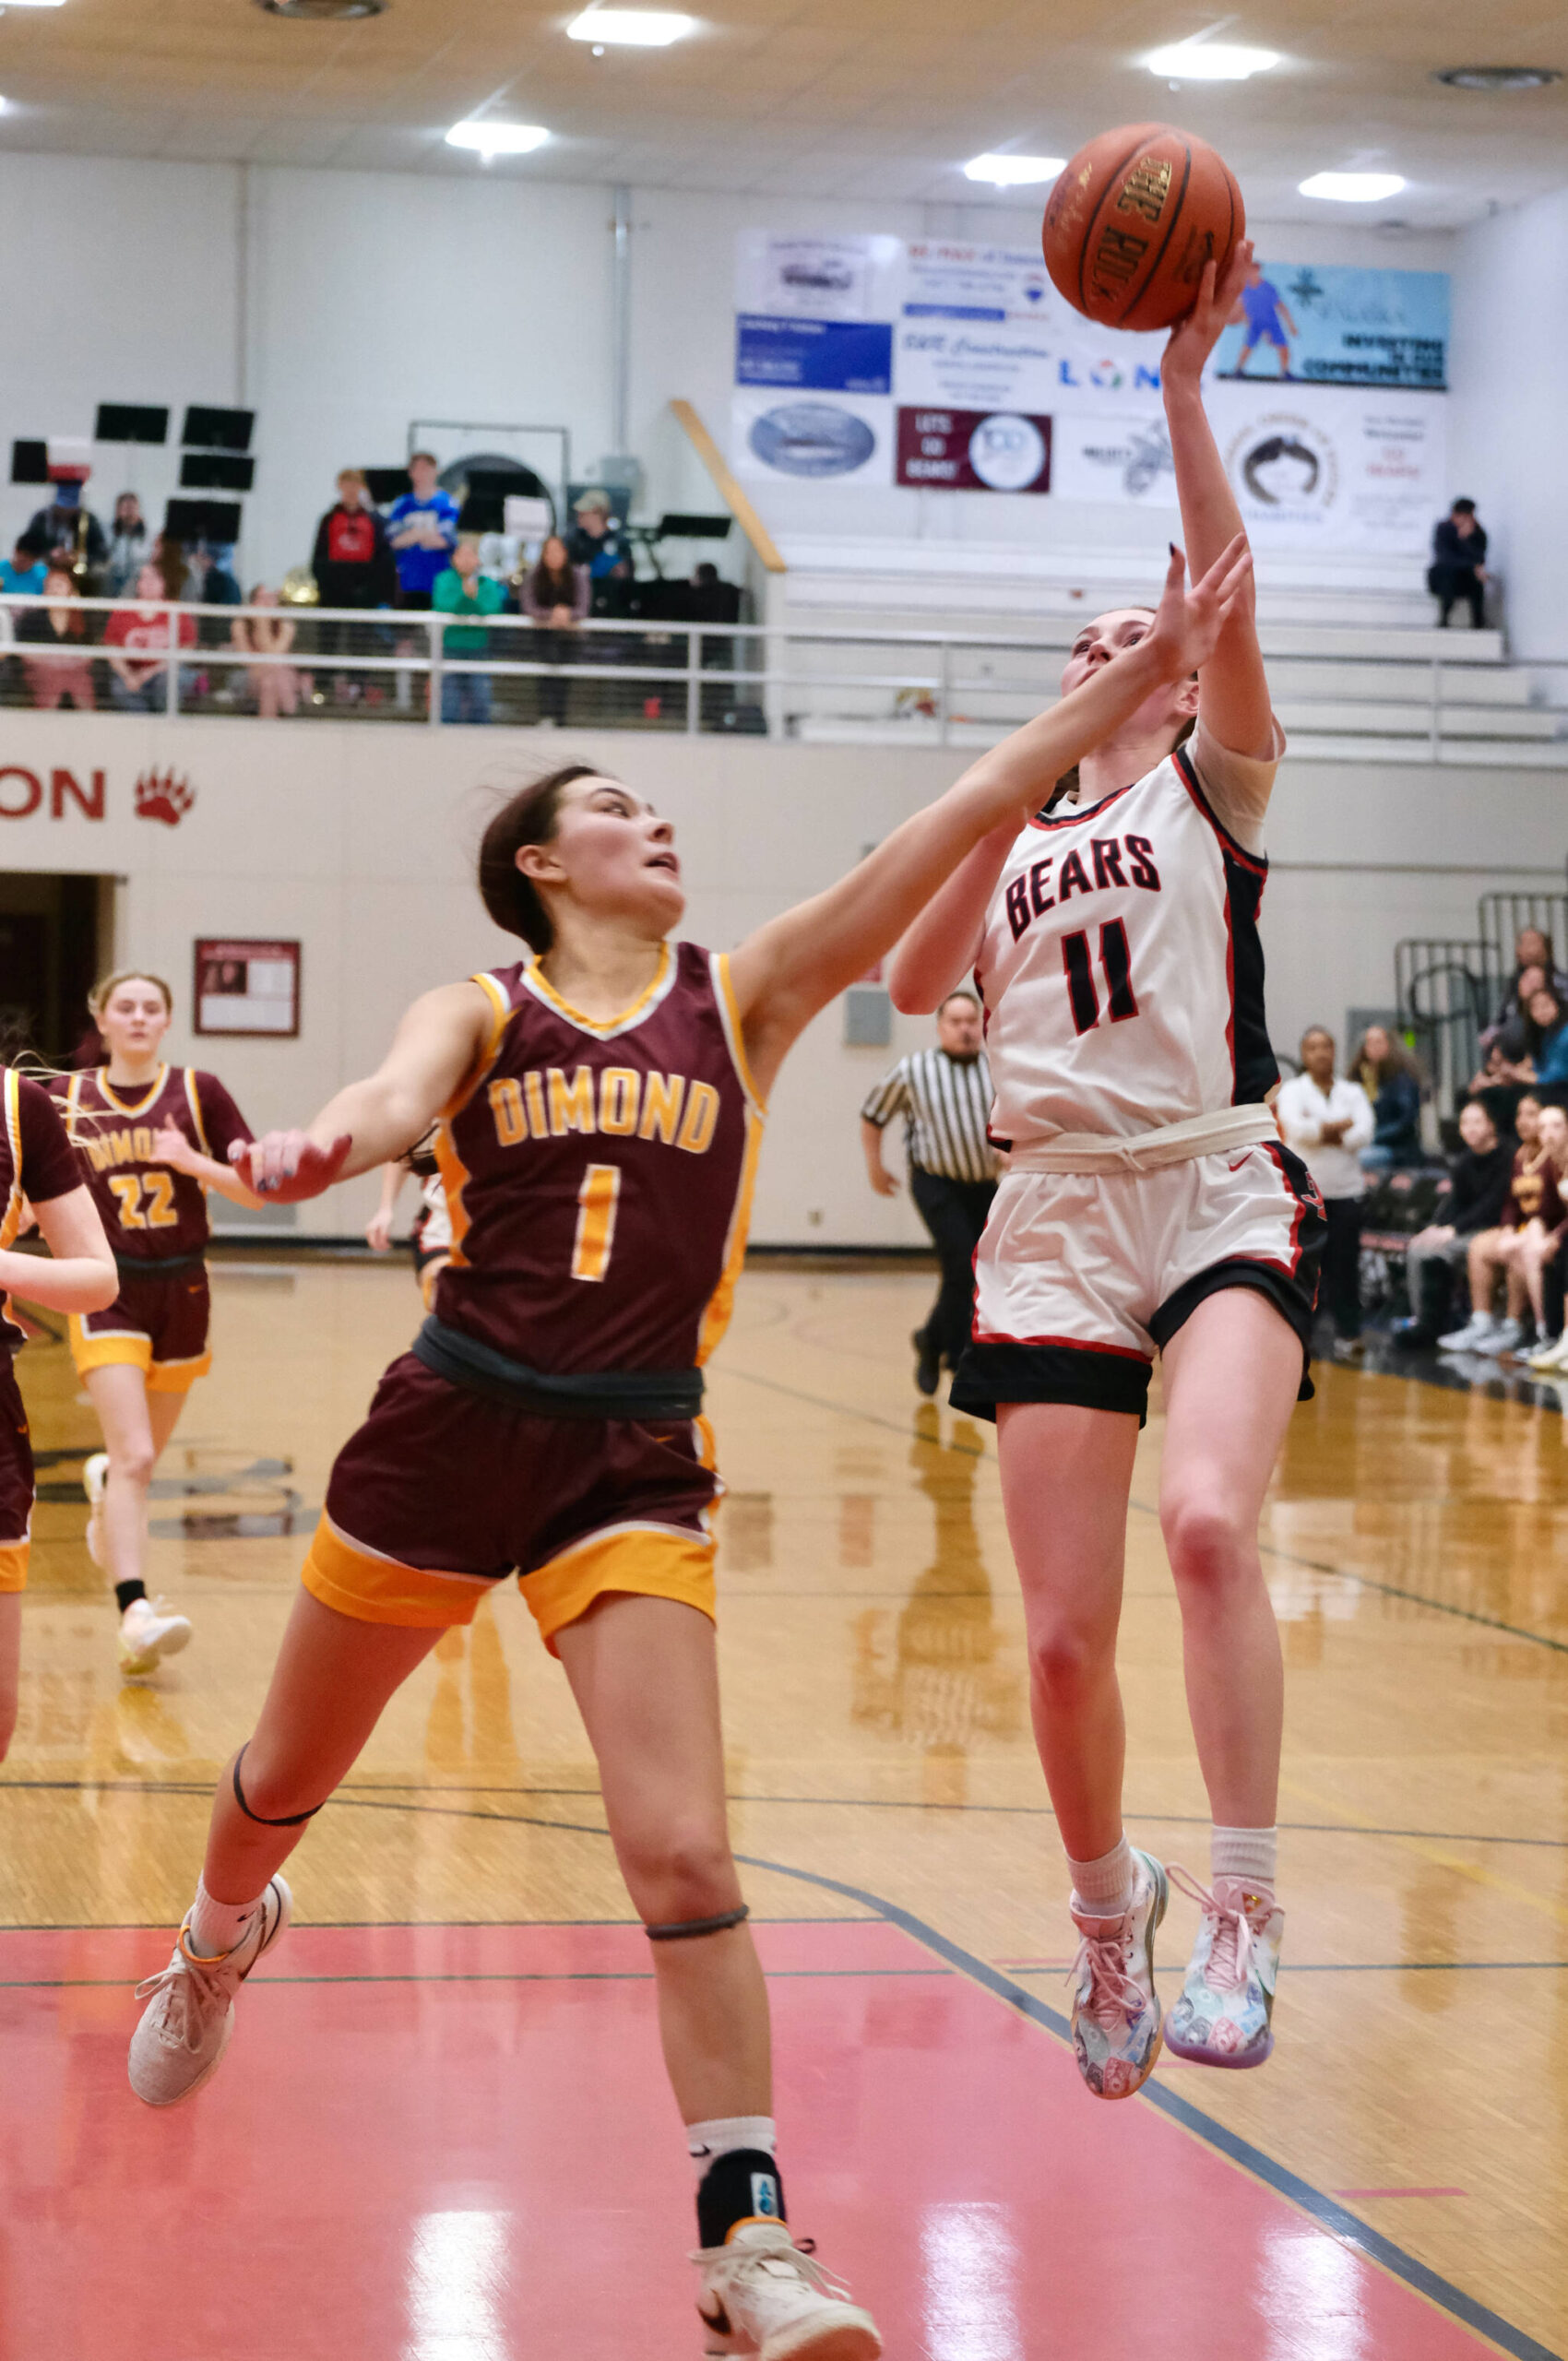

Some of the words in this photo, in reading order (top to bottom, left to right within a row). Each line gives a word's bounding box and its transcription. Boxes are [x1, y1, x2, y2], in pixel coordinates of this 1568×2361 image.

[1116, 157, 1172, 222] THE
[1059, 360, 1164, 390] LON
[1005, 834, 1161, 943] BEARS
[1062, 917, 1139, 1037] 11
[488, 1065, 720, 1154] DIMOND
[108, 1170, 178, 1229] 22
[571, 1163, 621, 1282] 1
